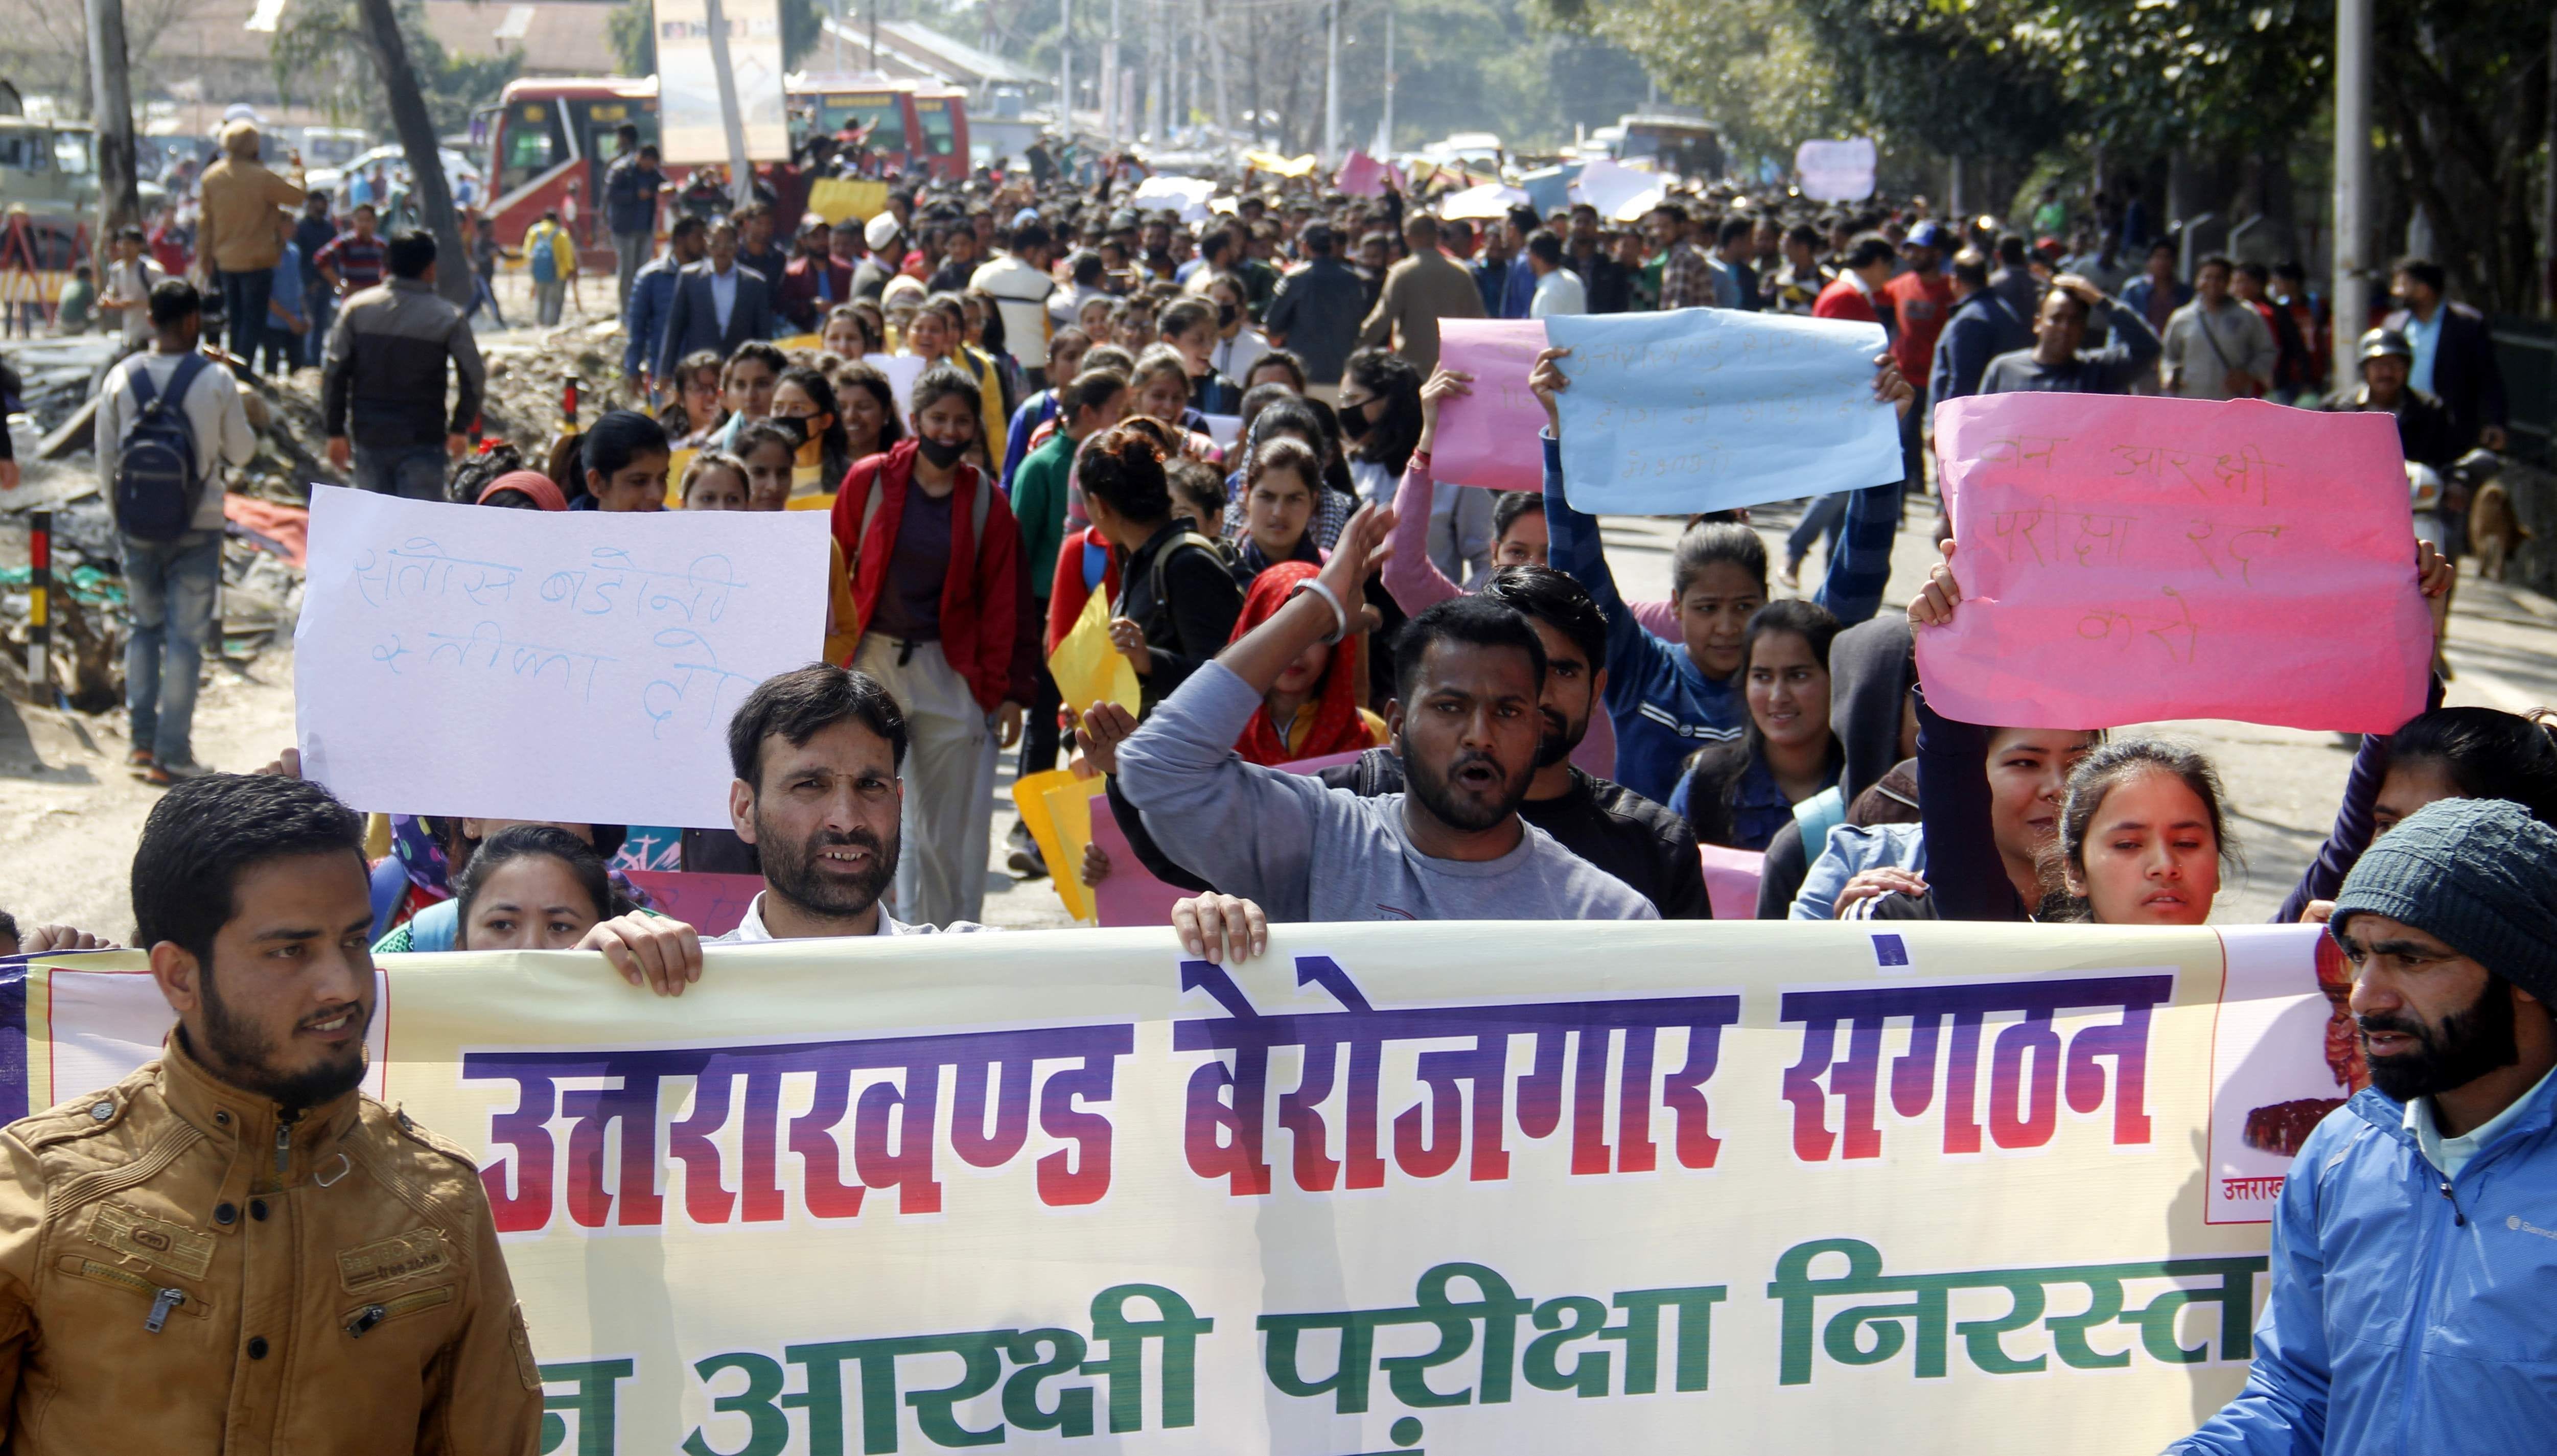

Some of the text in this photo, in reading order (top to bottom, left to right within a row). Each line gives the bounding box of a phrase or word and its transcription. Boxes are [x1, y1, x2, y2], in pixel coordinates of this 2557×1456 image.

[2077, 585, 2199, 665] करो
[462, 934, 2173, 1233] उत्तराखण्ड बेरोजगार संगठन
[2221, 1177, 2286, 1200] उत्तराख
[683, 1283, 1214, 1456] आरक्षी
[1256, 1262, 1727, 1415] परीक्षा
